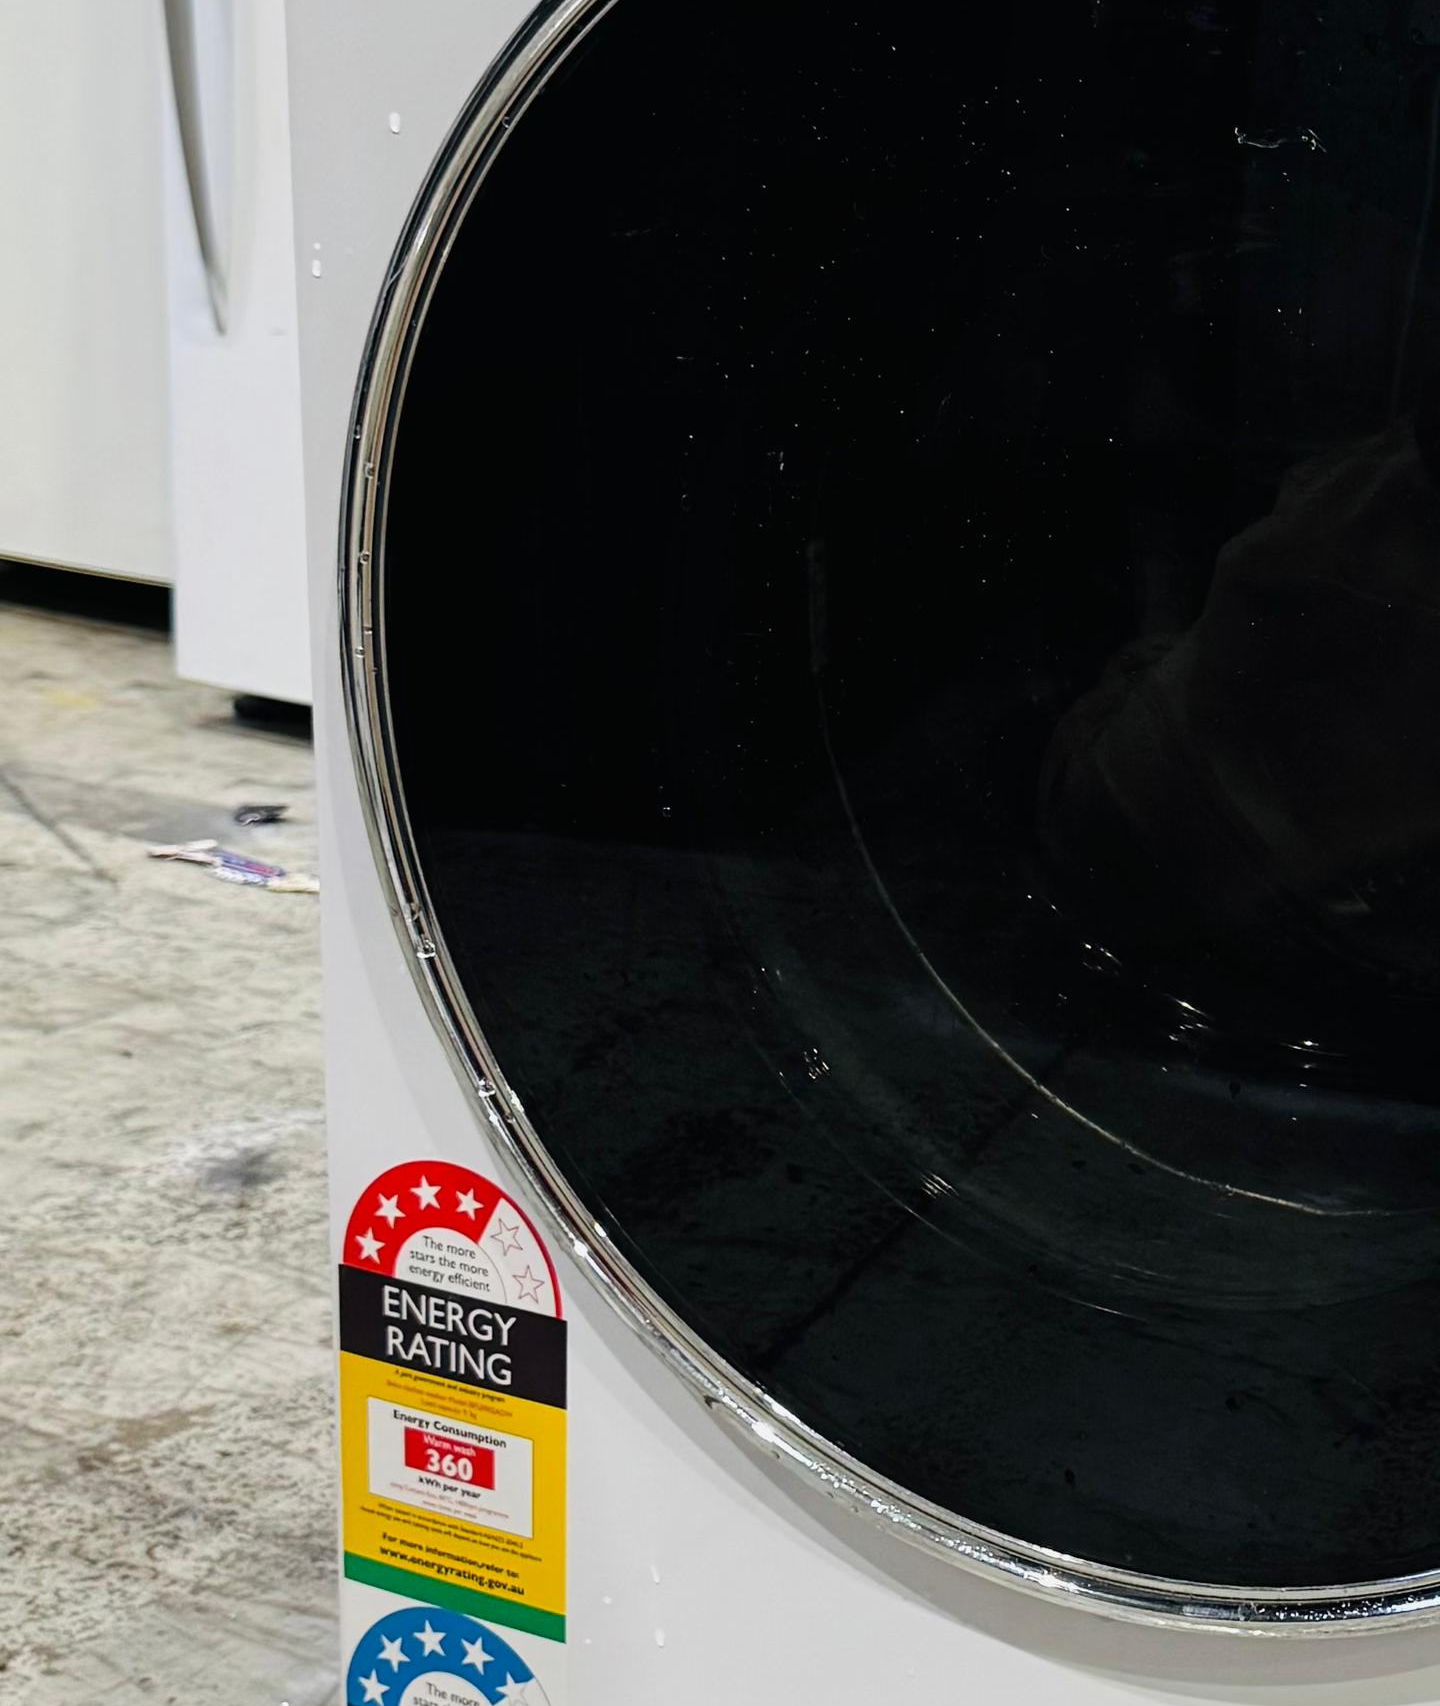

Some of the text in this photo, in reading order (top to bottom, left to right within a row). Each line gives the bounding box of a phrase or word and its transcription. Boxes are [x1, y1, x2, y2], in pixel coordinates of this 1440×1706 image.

[410, 1250, 489, 1277] stars the more
[422, 1235, 476, 1260] The more
[409, 1265, 491, 1292] energy efficient
[383, 1284, 517, 1346] ENERGY
[386, 1325, 512, 1386] RATING
[393, 1409, 430, 1429] Energy
[433, 1420, 507, 1449] Consumption
[425, 1448, 474, 1482] 360
[379, 1546, 525, 1596] www.energyrating.gov.au
[426, 1682, 448, 1700] The
